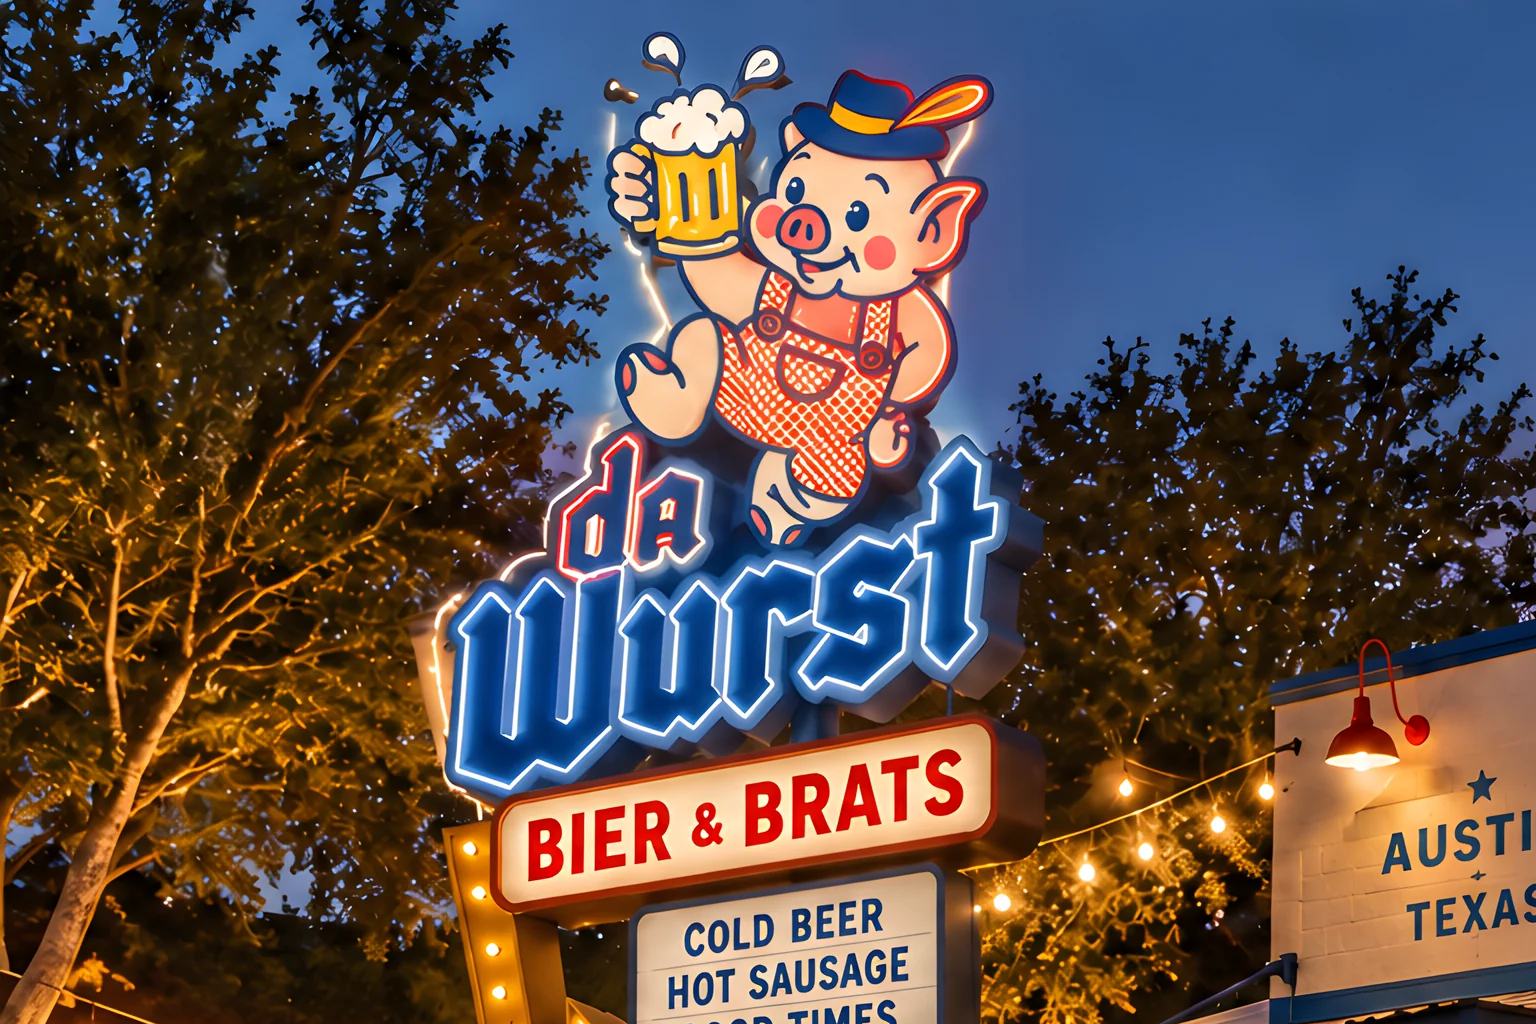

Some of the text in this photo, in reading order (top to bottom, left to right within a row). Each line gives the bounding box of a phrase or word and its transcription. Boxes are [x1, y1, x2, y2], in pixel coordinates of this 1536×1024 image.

[455, 446, 999, 790] Wurst
[528, 748, 964, 882] BIER & BRATS
[668, 945, 909, 1009] HOT SAUSAGE
[684, 898, 883, 957] COLD BEER
